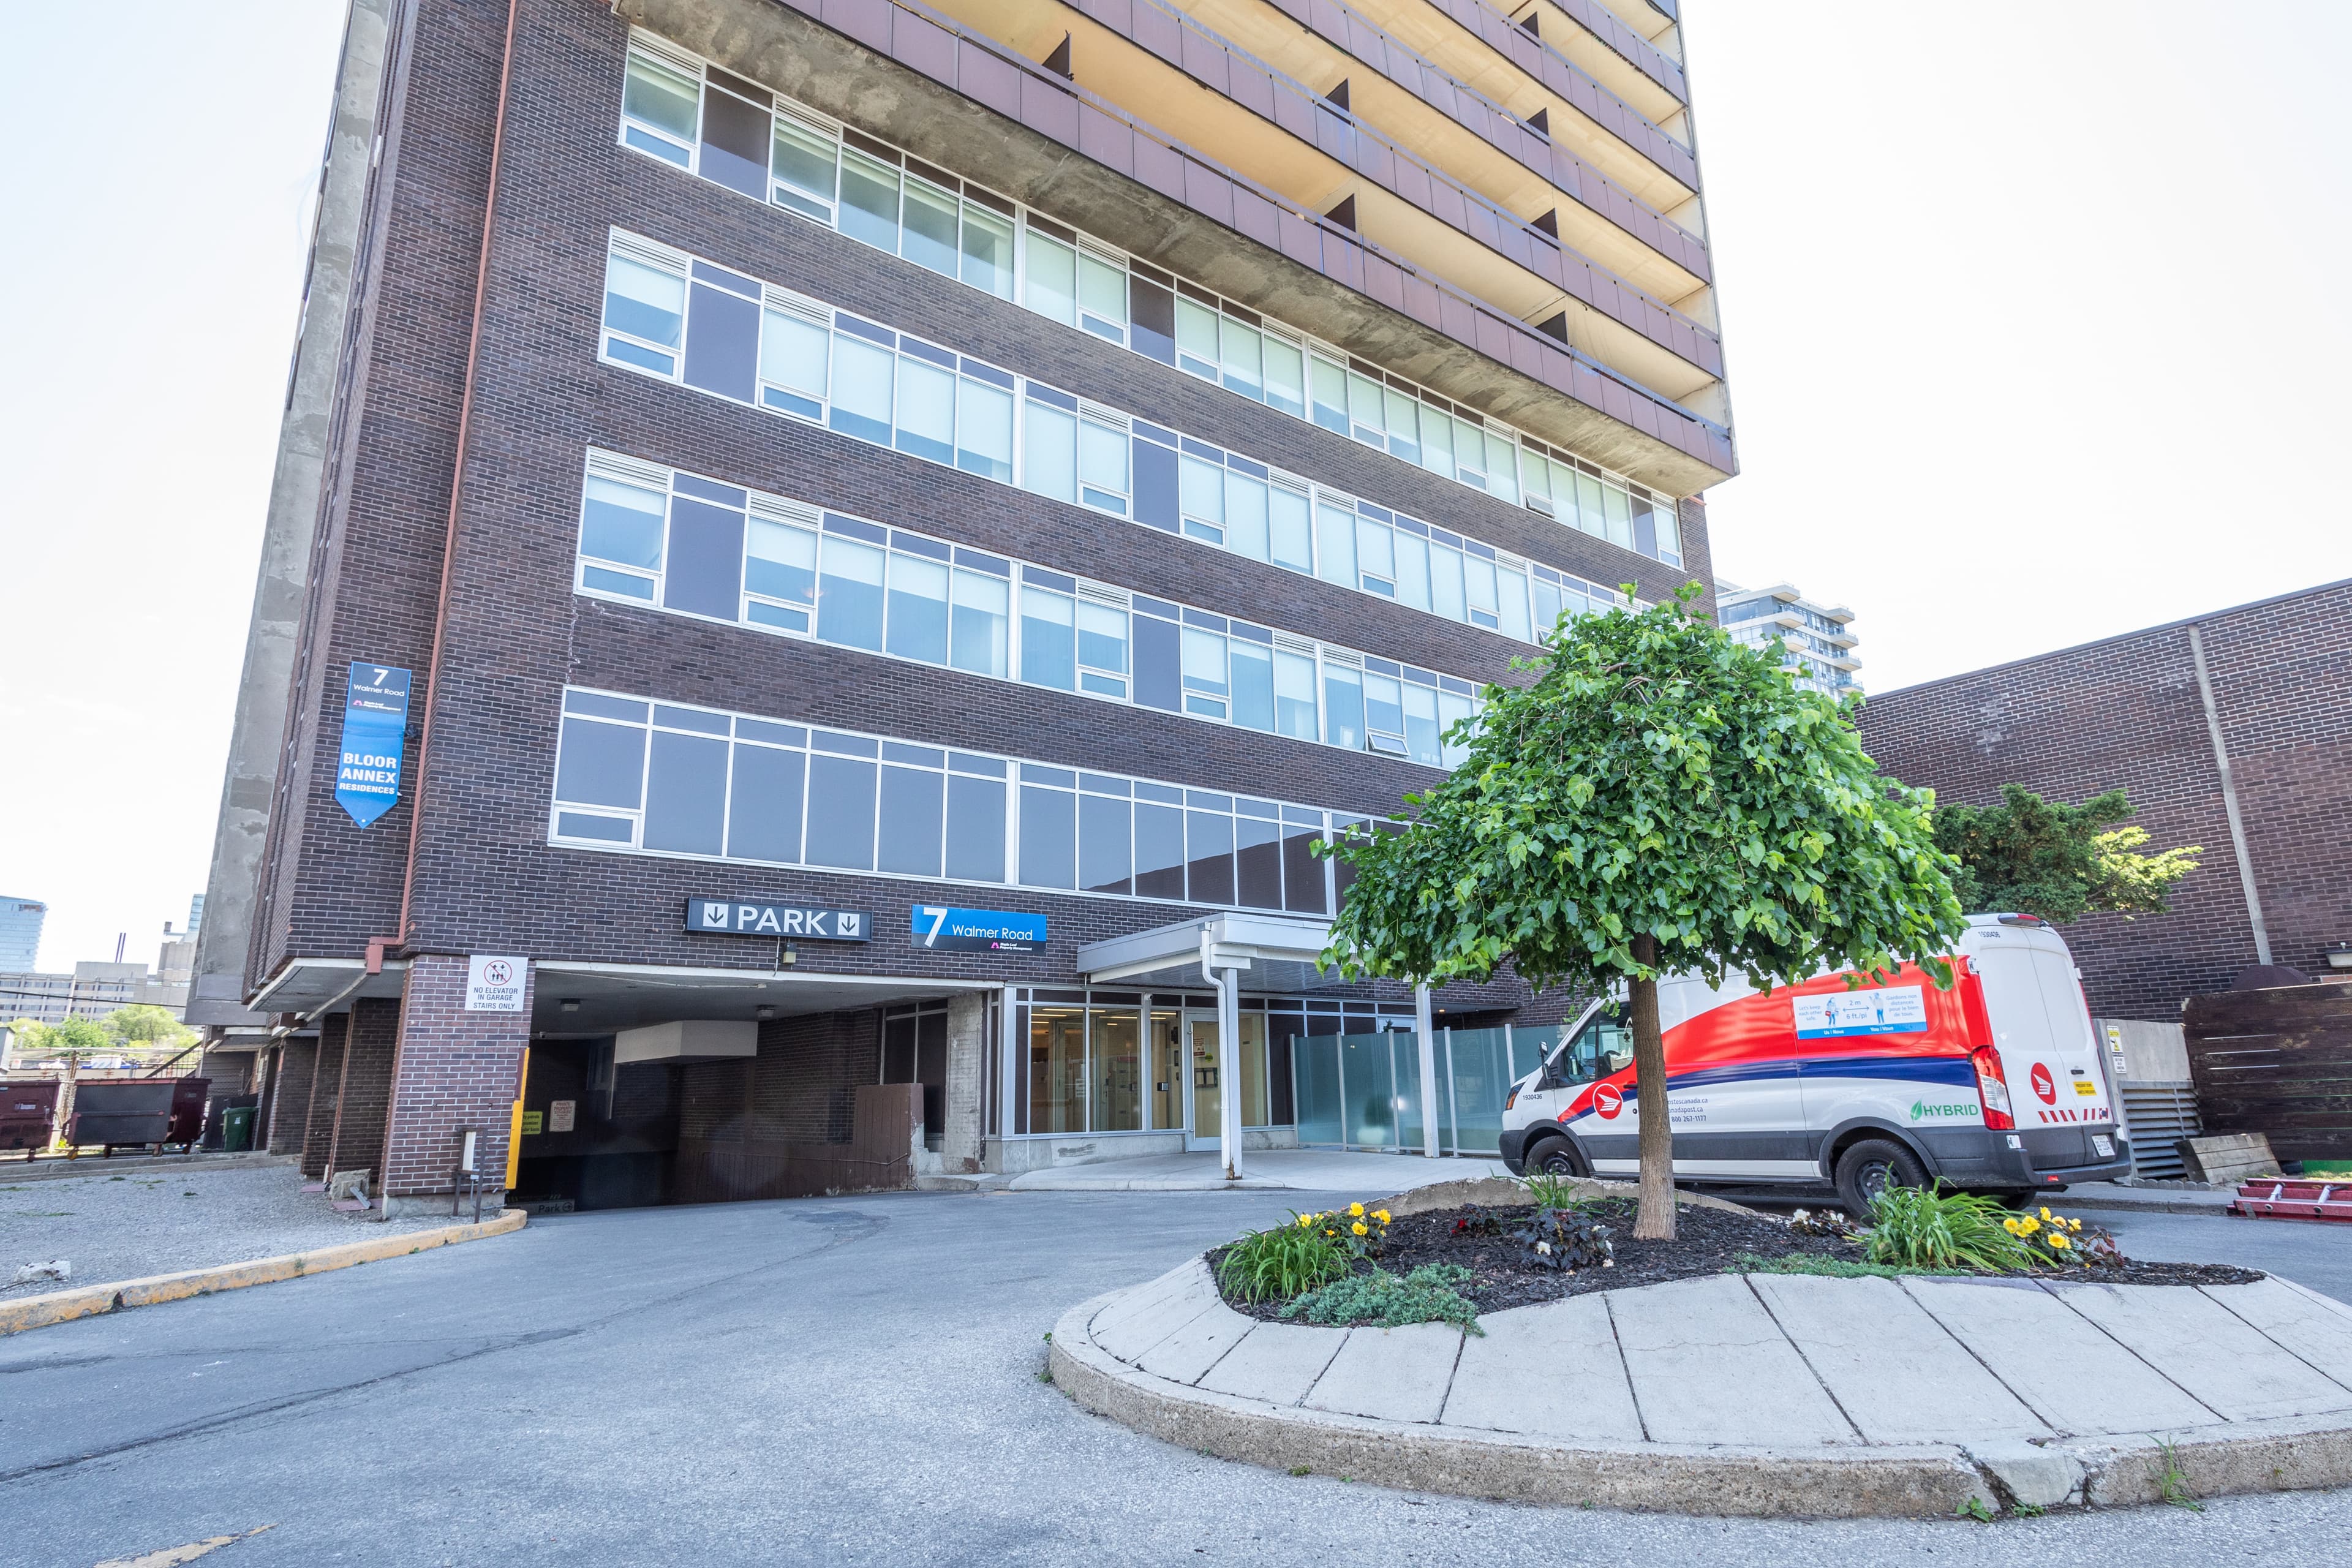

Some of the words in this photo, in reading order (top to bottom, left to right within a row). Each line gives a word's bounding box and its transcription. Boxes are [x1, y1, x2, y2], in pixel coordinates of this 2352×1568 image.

[374, 668, 388, 686] 7
[353, 684, 383, 693] Walmer
[384, 688, 405, 696] Road
[343, 752, 397, 769] BLOOR
[341, 767, 396, 784] ANNEX
[339, 782, 395, 794] RESIDENCES
[737, 905, 828, 935] PARK
[923, 907, 948, 948] 7
[952, 924, 999, 938] Walmer
[1001, 927, 1033, 941] Road
[1923, 1104, 1978, 1116] HYBRID
[539, 1204, 560, 1213] Park
